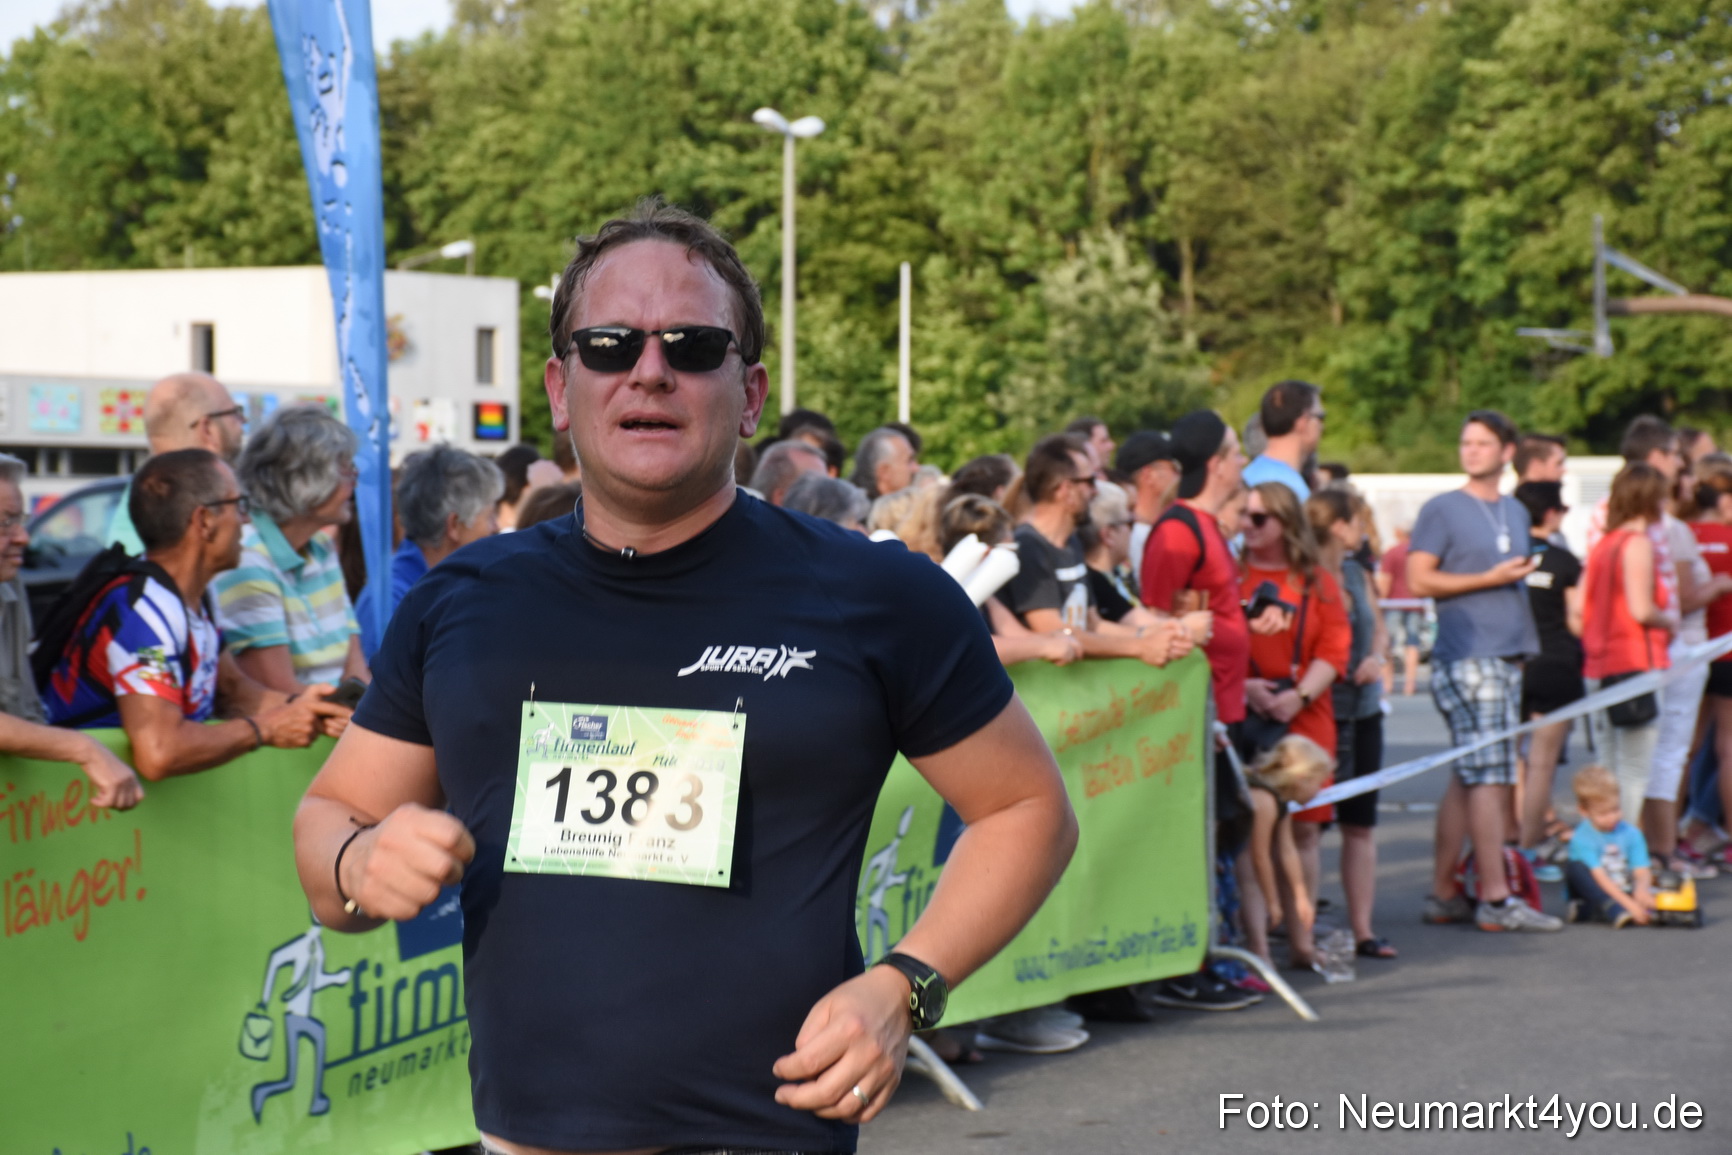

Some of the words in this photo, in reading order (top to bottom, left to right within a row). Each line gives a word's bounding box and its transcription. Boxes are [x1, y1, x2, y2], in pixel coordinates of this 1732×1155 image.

[677, 645, 778, 677] JURA
[553, 737, 638, 757] firmenlauf
[545, 767, 704, 832] 1383
[543, 845, 605, 858] Lebenshilfe
[560, 828, 622, 848] Breunig
[4, 827, 147, 942] länger!
[348, 1027, 470, 1097] neumarkt
